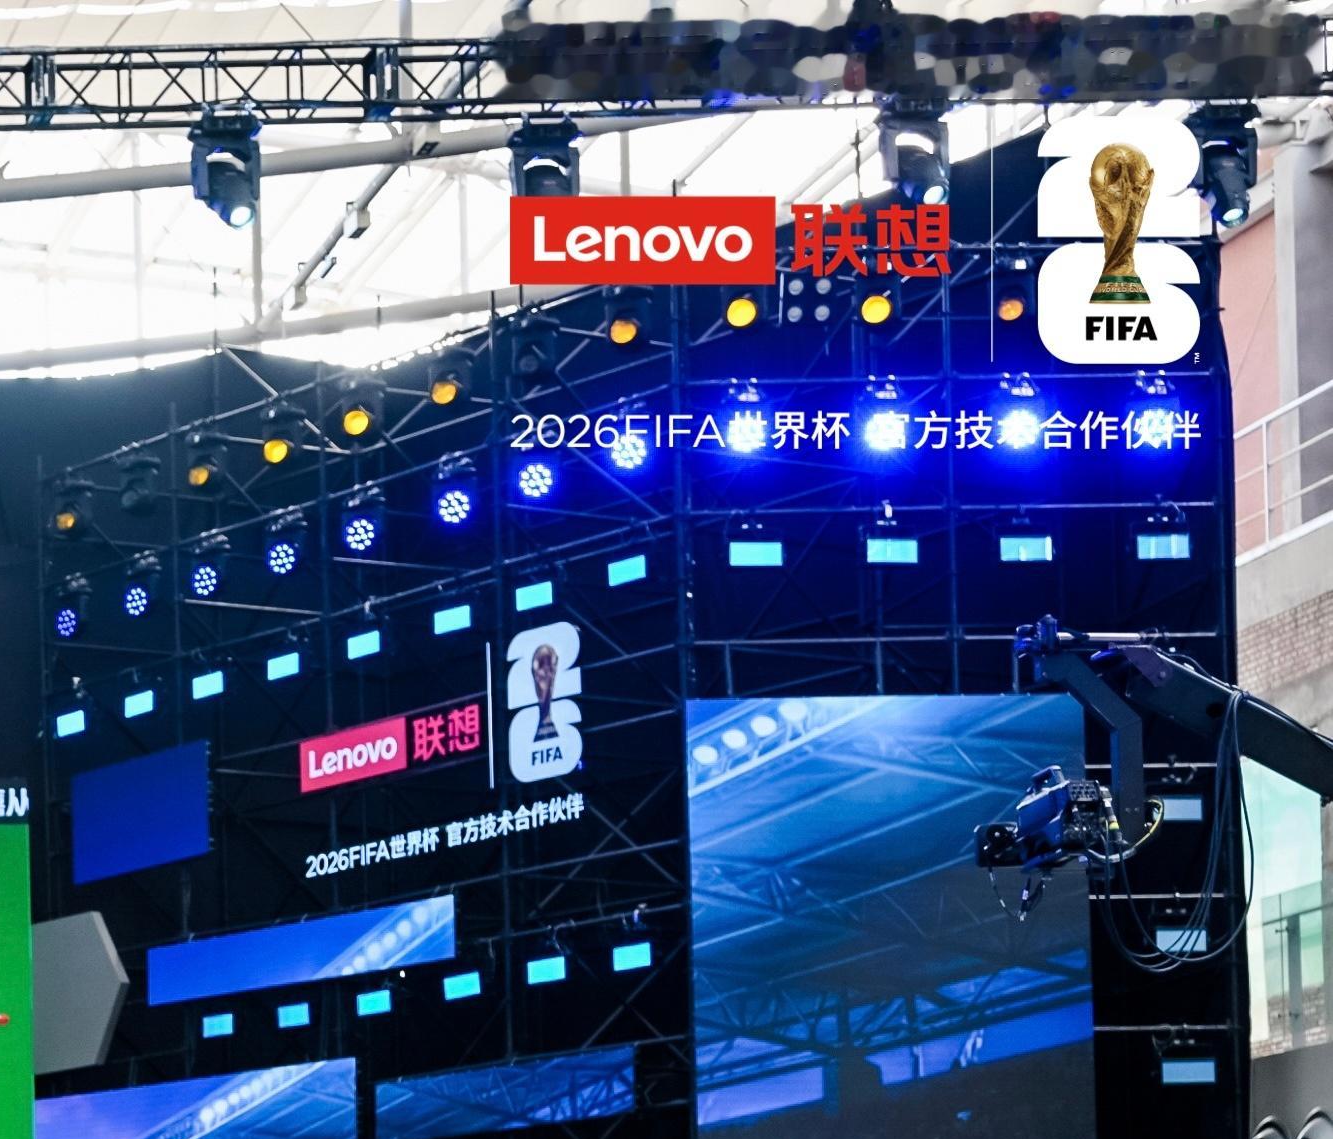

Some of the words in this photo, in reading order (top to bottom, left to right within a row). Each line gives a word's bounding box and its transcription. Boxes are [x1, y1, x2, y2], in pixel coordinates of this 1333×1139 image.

[308, 736, 398, 779] Lenovo
[413, 704, 480, 761] 联想
[531, 746, 563, 766] FIFA
[305, 826, 440, 878] 2026FIFA世界杯
[446, 793, 584, 847] 官方技术合作伙伴
